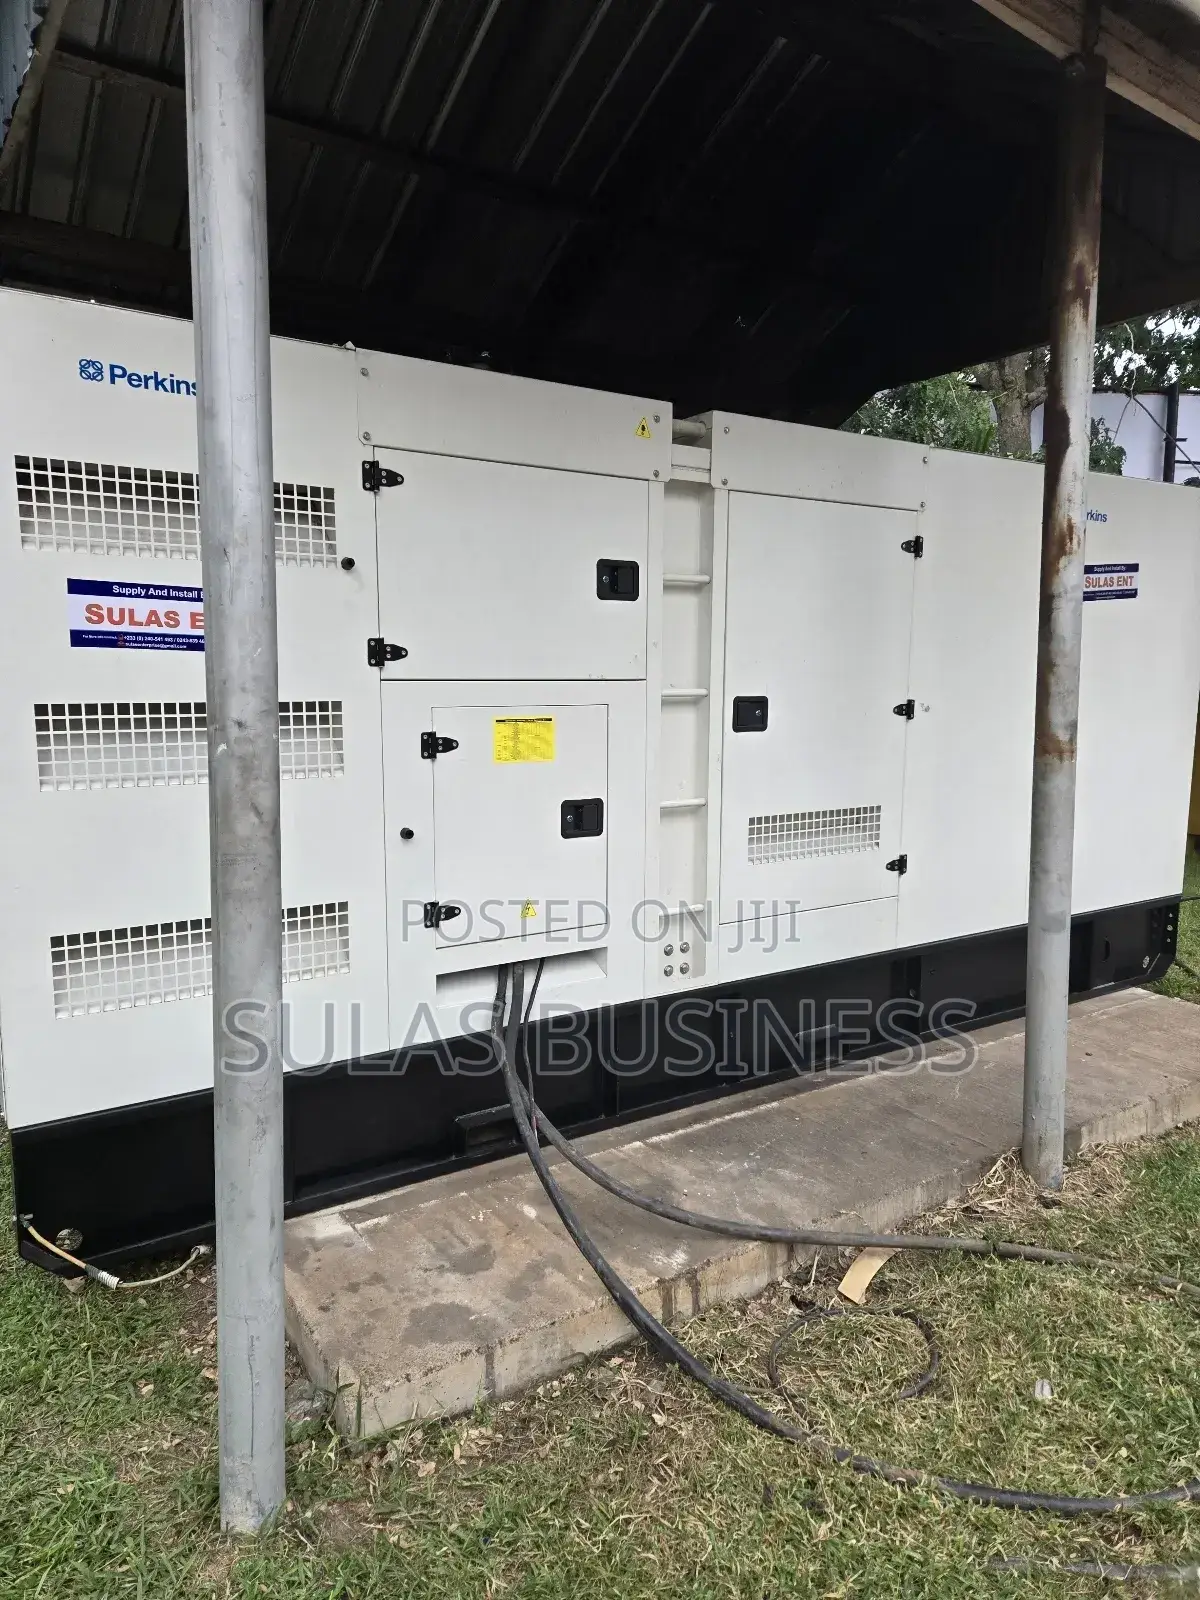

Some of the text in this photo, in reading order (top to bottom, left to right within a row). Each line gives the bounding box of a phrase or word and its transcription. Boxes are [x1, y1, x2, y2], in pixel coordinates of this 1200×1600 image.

[1086, 510, 1107, 522] rkins
[1085, 576, 1134, 588] SULAS ENT
[112, 585, 146, 597] Supply
[148, 588, 168, 596] And
[170, 589, 198, 598] Install
[85, 603, 181, 629] SULAS
